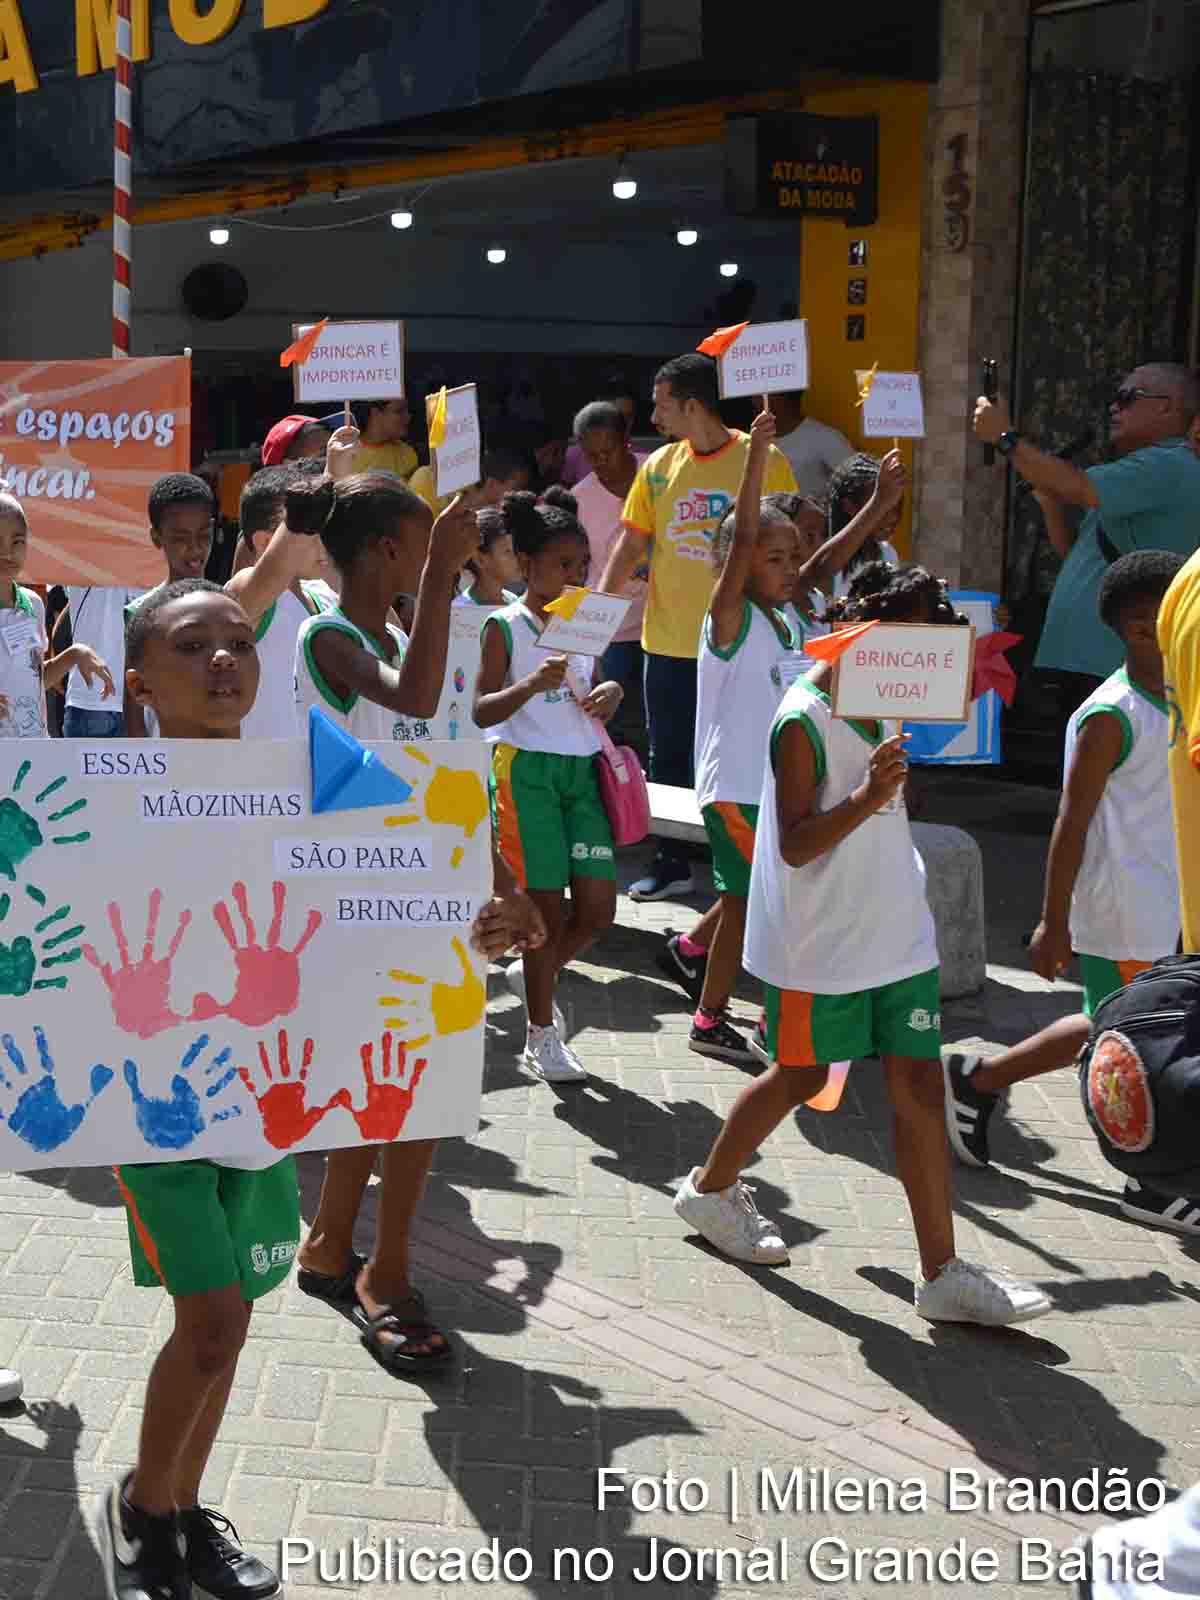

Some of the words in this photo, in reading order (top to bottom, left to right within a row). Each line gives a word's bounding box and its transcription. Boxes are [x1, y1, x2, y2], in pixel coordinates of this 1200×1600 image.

[310, 343, 376, 360] BRINCAR
[302, 367, 398, 385] IMPORTANTE!
[16, 406, 177, 449] espaços
[855, 650, 937, 669] BRINCAR
[943, 648, 953, 669] É
[875, 682, 928, 700] VIDA!
[82, 751, 167, 776] ESSAS
[142, 790, 302, 817] MÃOZINHAS
[289, 842, 347, 870] SÃO
[355, 846, 427, 869] PARA
[337, 897, 472, 922] BRINCAR!
